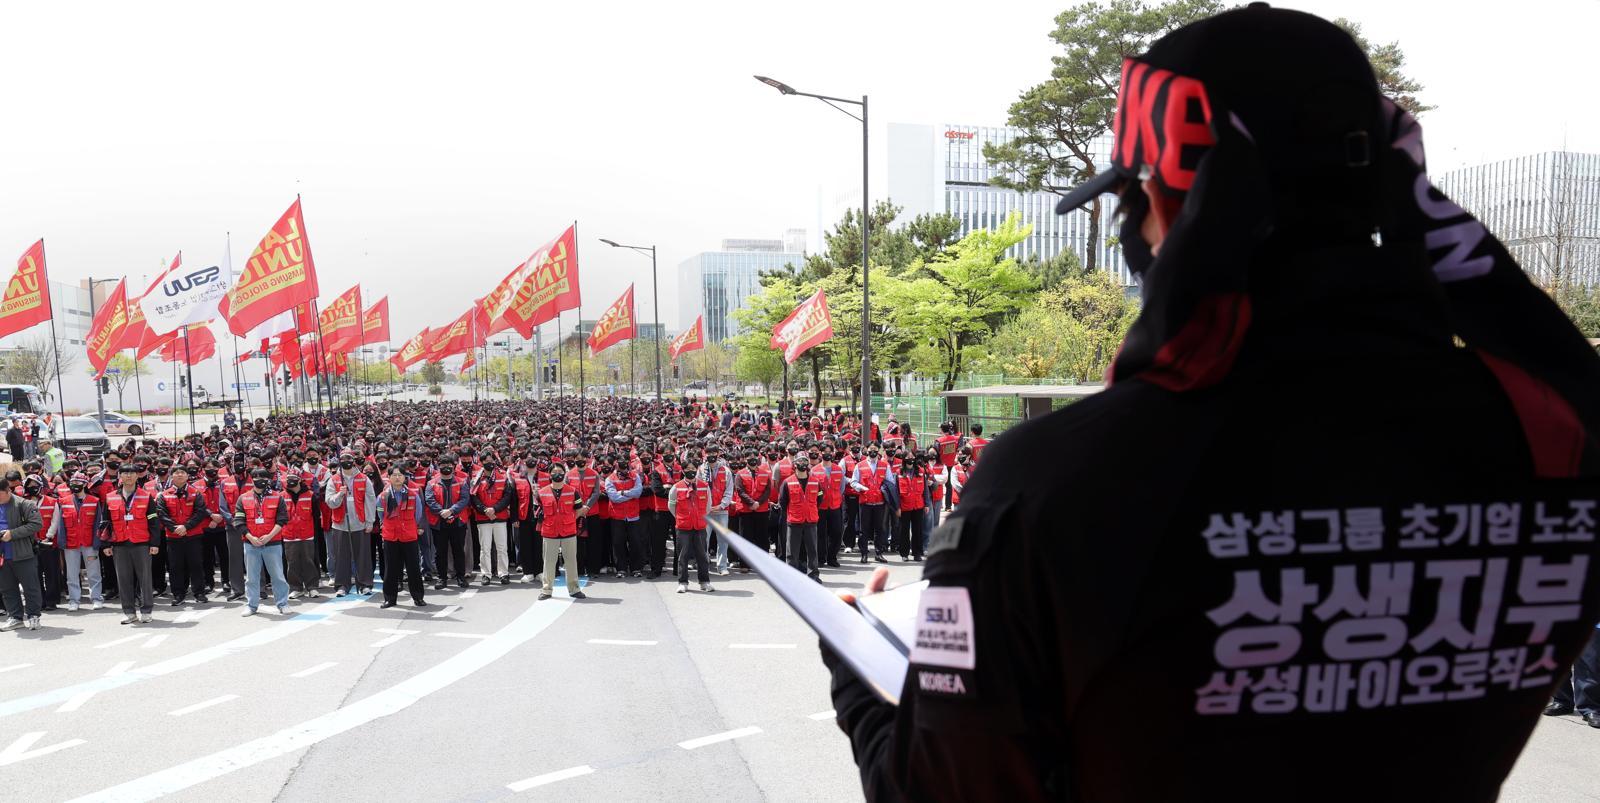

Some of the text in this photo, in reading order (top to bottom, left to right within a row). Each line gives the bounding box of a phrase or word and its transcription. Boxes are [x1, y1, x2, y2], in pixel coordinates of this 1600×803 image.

[1202, 500, 1596, 558] 삼성그룹 초기업 노조
[1205, 554, 1590, 669] 상생지부
[918, 671, 966, 694] KOREA
[1195, 645, 1558, 715] 삼성바이오로직스
